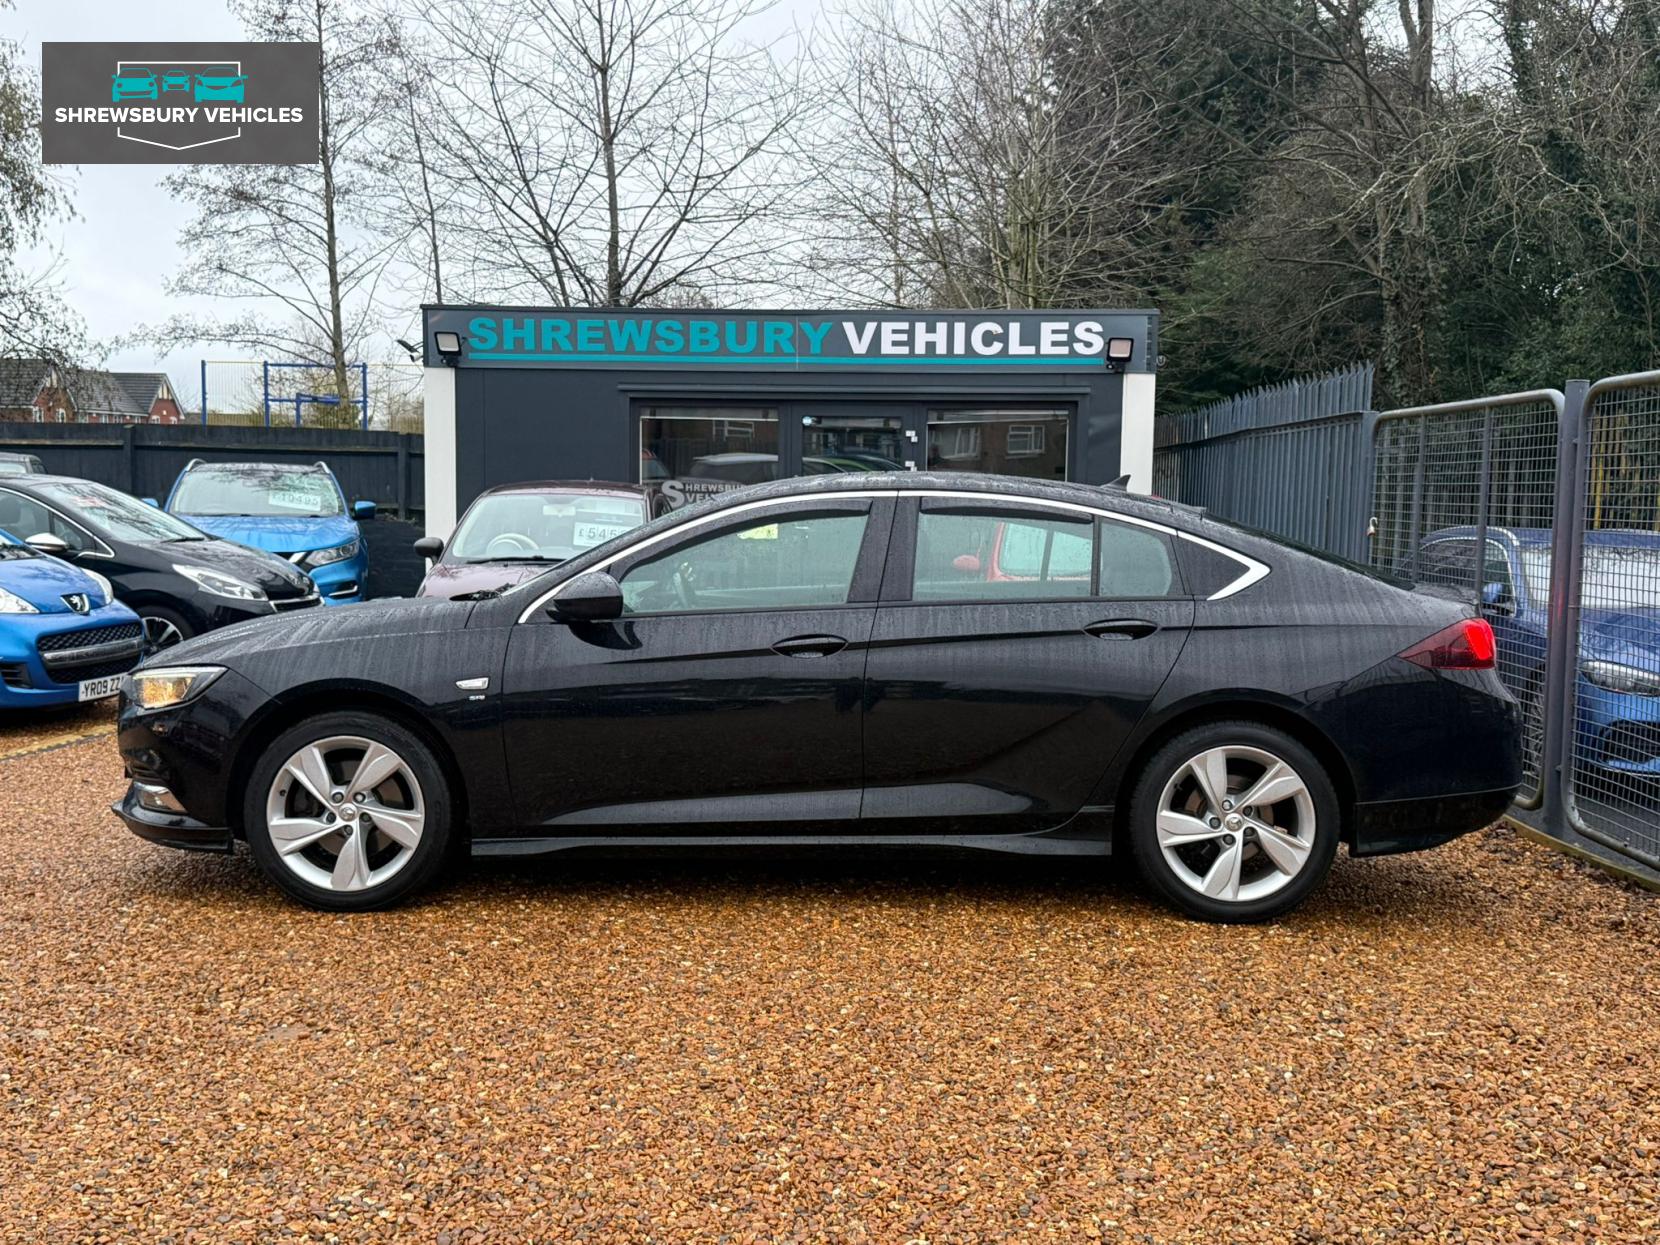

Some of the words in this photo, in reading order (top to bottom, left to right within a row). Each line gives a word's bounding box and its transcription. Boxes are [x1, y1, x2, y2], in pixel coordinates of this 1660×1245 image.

[468, 317, 833, 354] SHREWSBURY
[841, 320, 1105, 355] VEHICLES
[84, 680, 109, 697] YR09
[110, 676, 125, 692] ZZ
